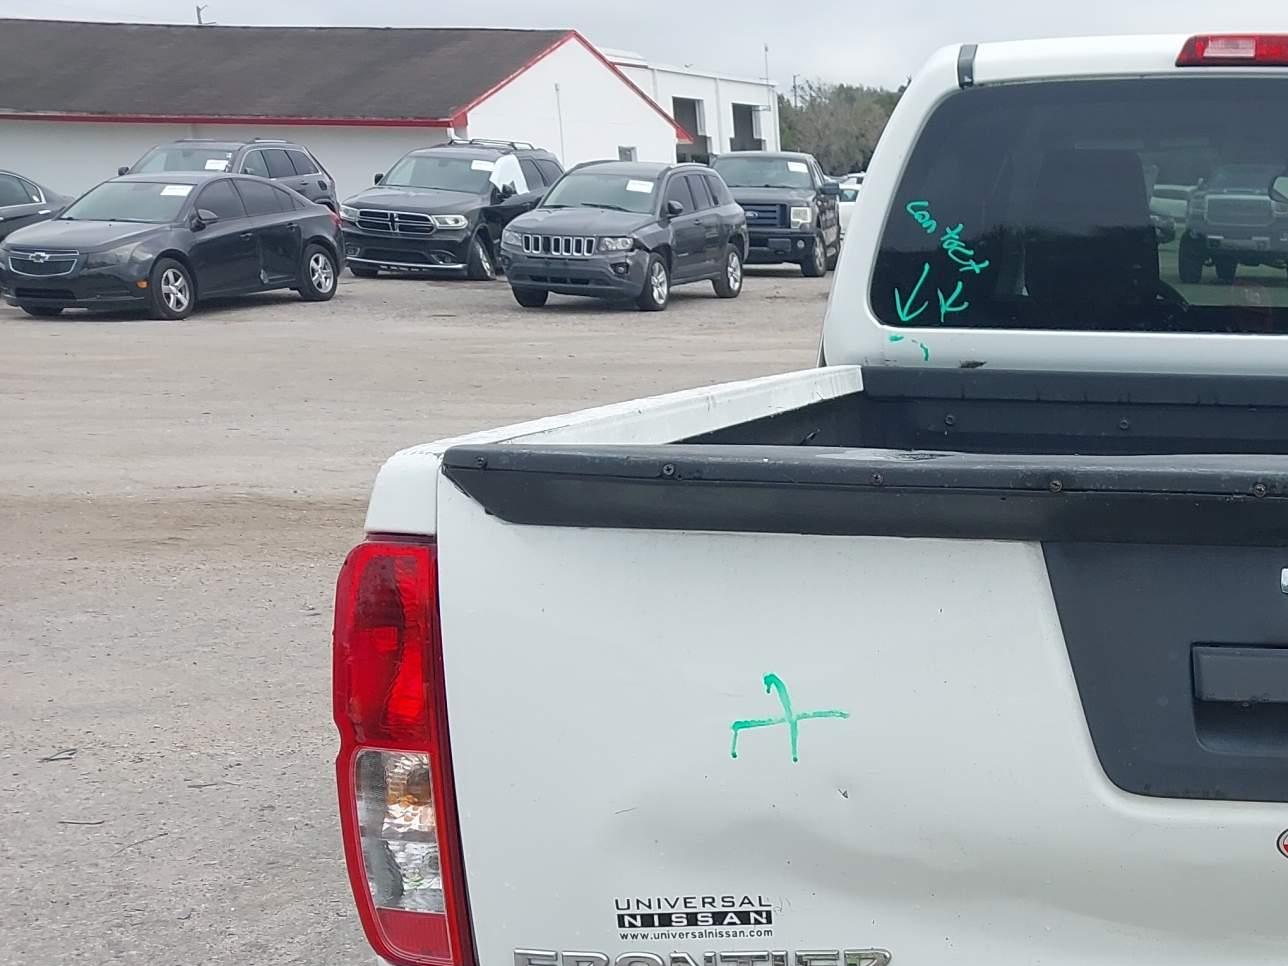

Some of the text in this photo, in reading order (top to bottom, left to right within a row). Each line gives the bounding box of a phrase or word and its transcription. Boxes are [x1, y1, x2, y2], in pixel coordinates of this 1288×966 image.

[614, 895, 772, 910] UNIVERSAL
[623, 911, 767, 928] NISSAN
[619, 929, 773, 940] www.universalnissan.com
